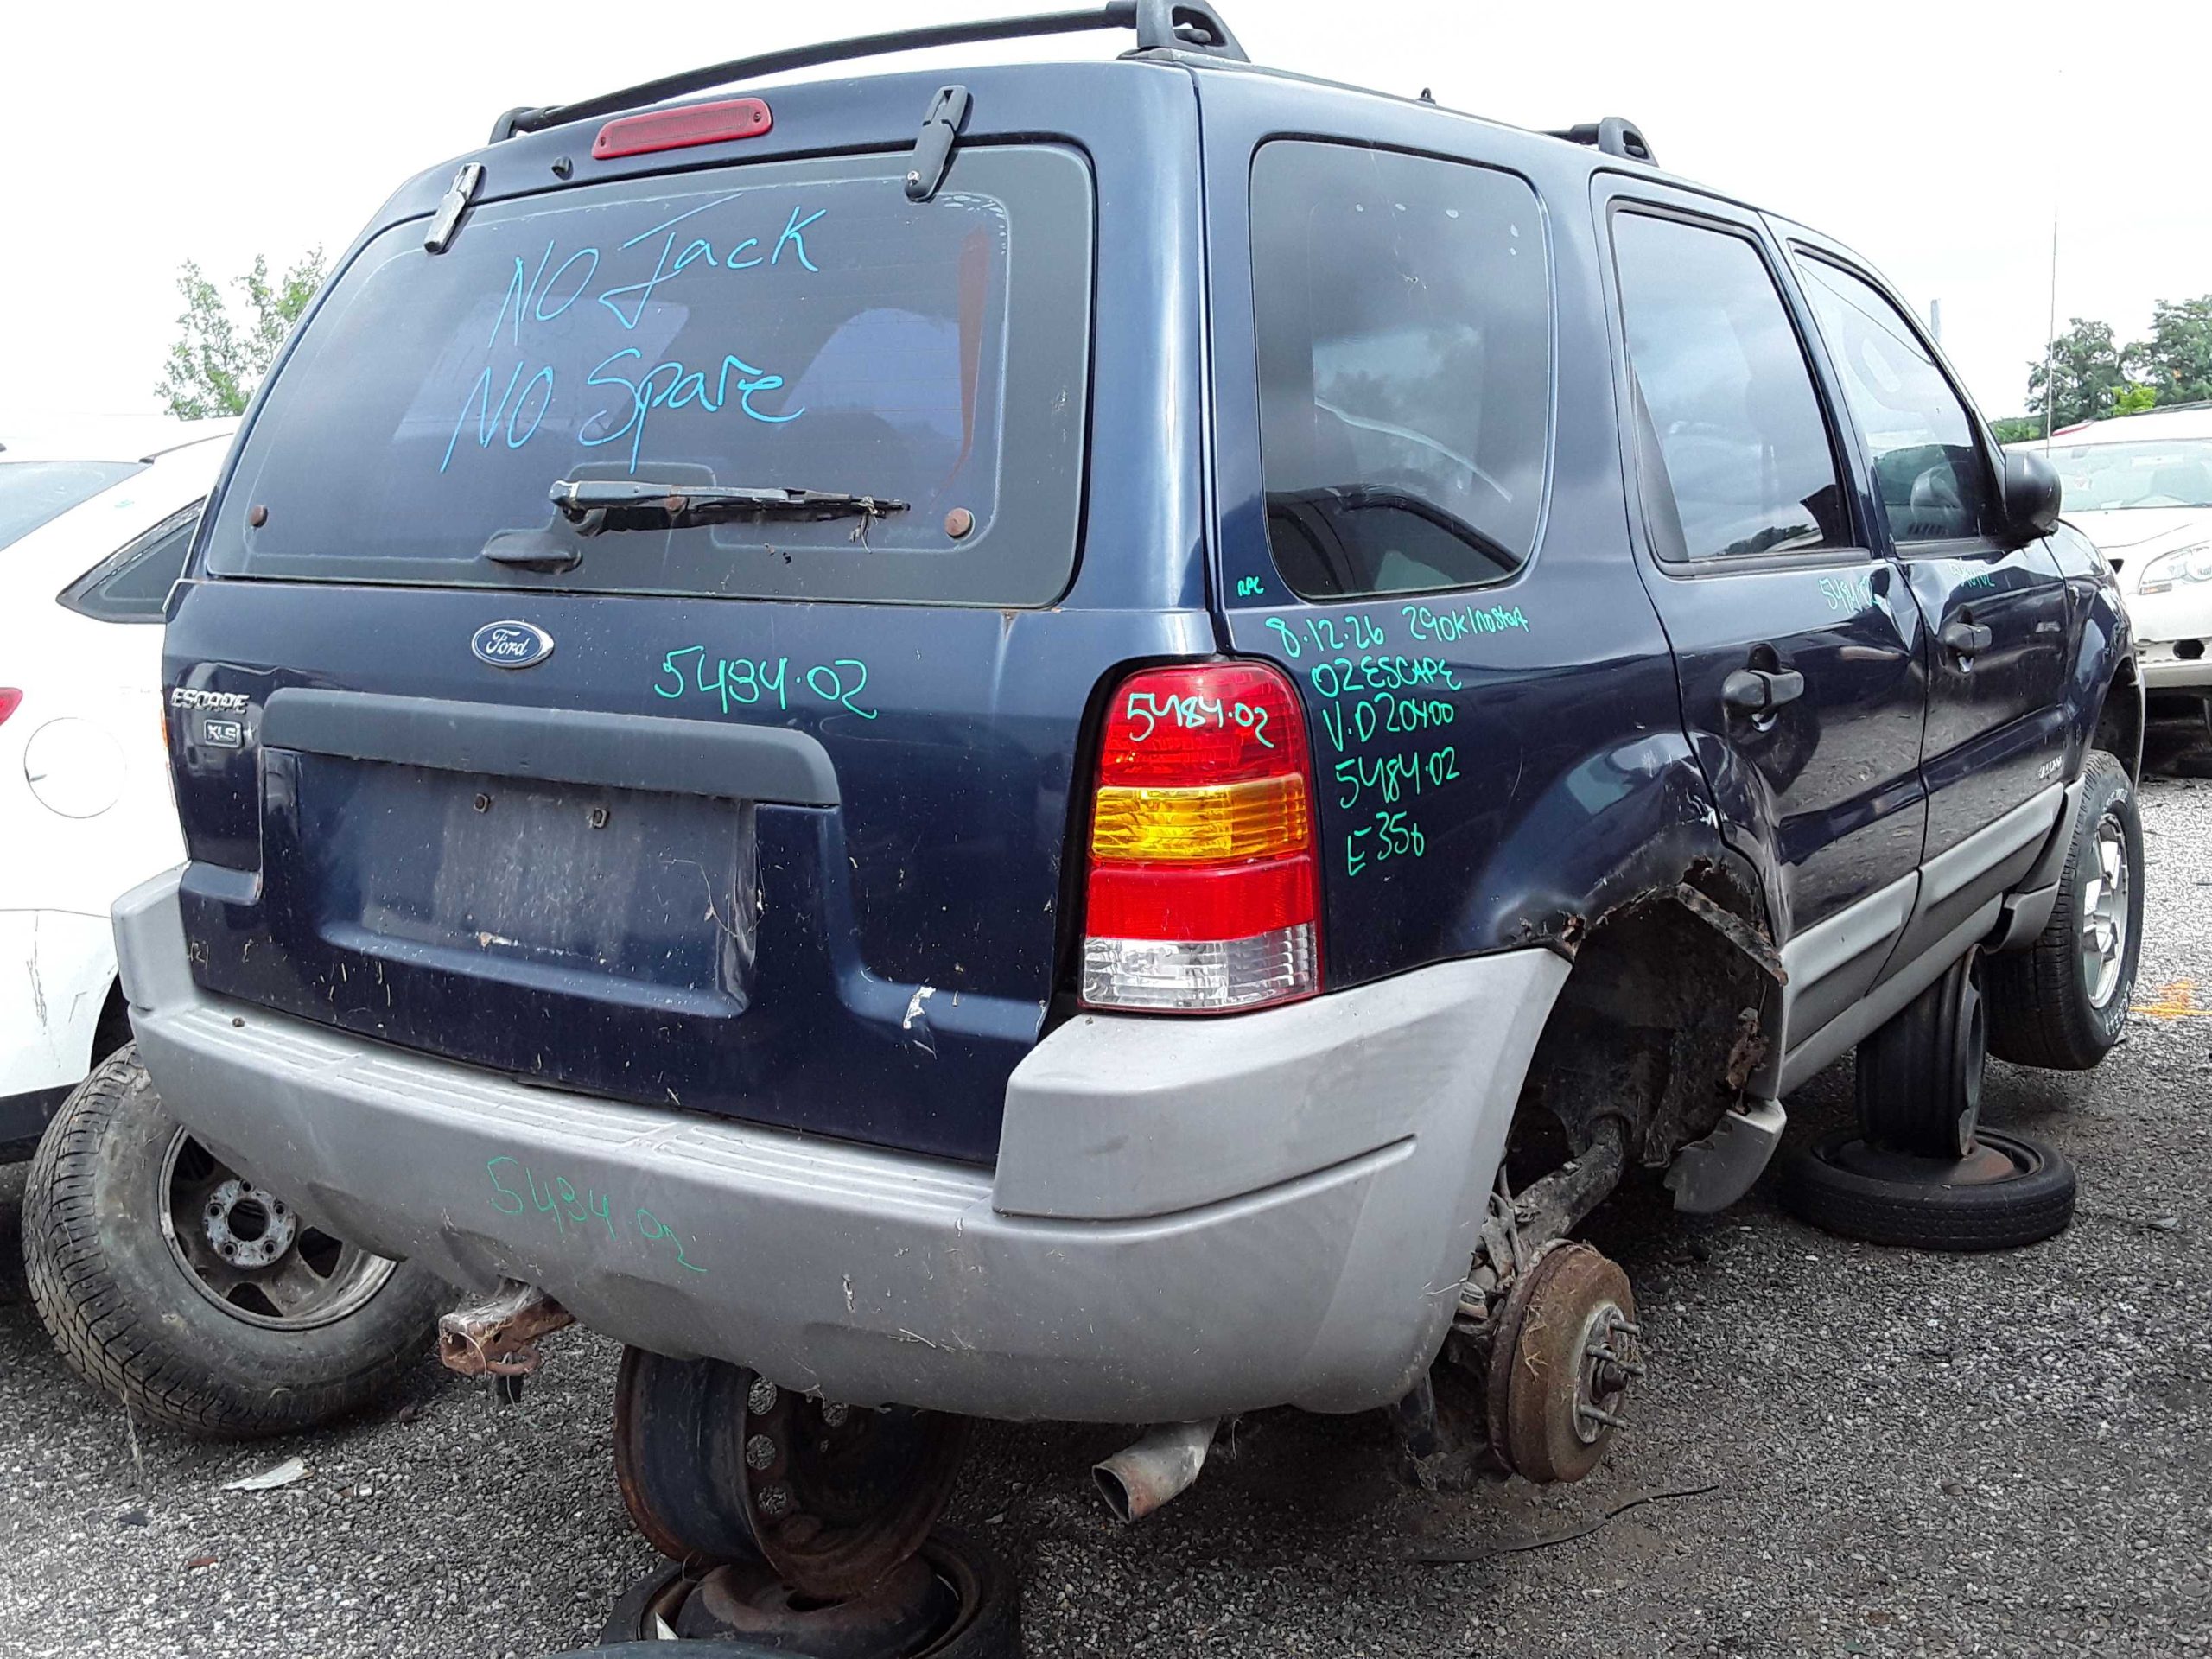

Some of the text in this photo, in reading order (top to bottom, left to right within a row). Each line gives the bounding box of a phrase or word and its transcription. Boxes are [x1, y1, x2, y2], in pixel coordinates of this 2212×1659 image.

[598, 192, 827, 329] Jack
[578, 347, 805, 474] Spare
[486, 629, 530, 657] Ford
[171, 687, 251, 715] ESCAPE
[653, 645, 878, 720] 5484.02
[207, 724, 237, 741] XLS
[1335, 746, 1461, 809] 5484.02
